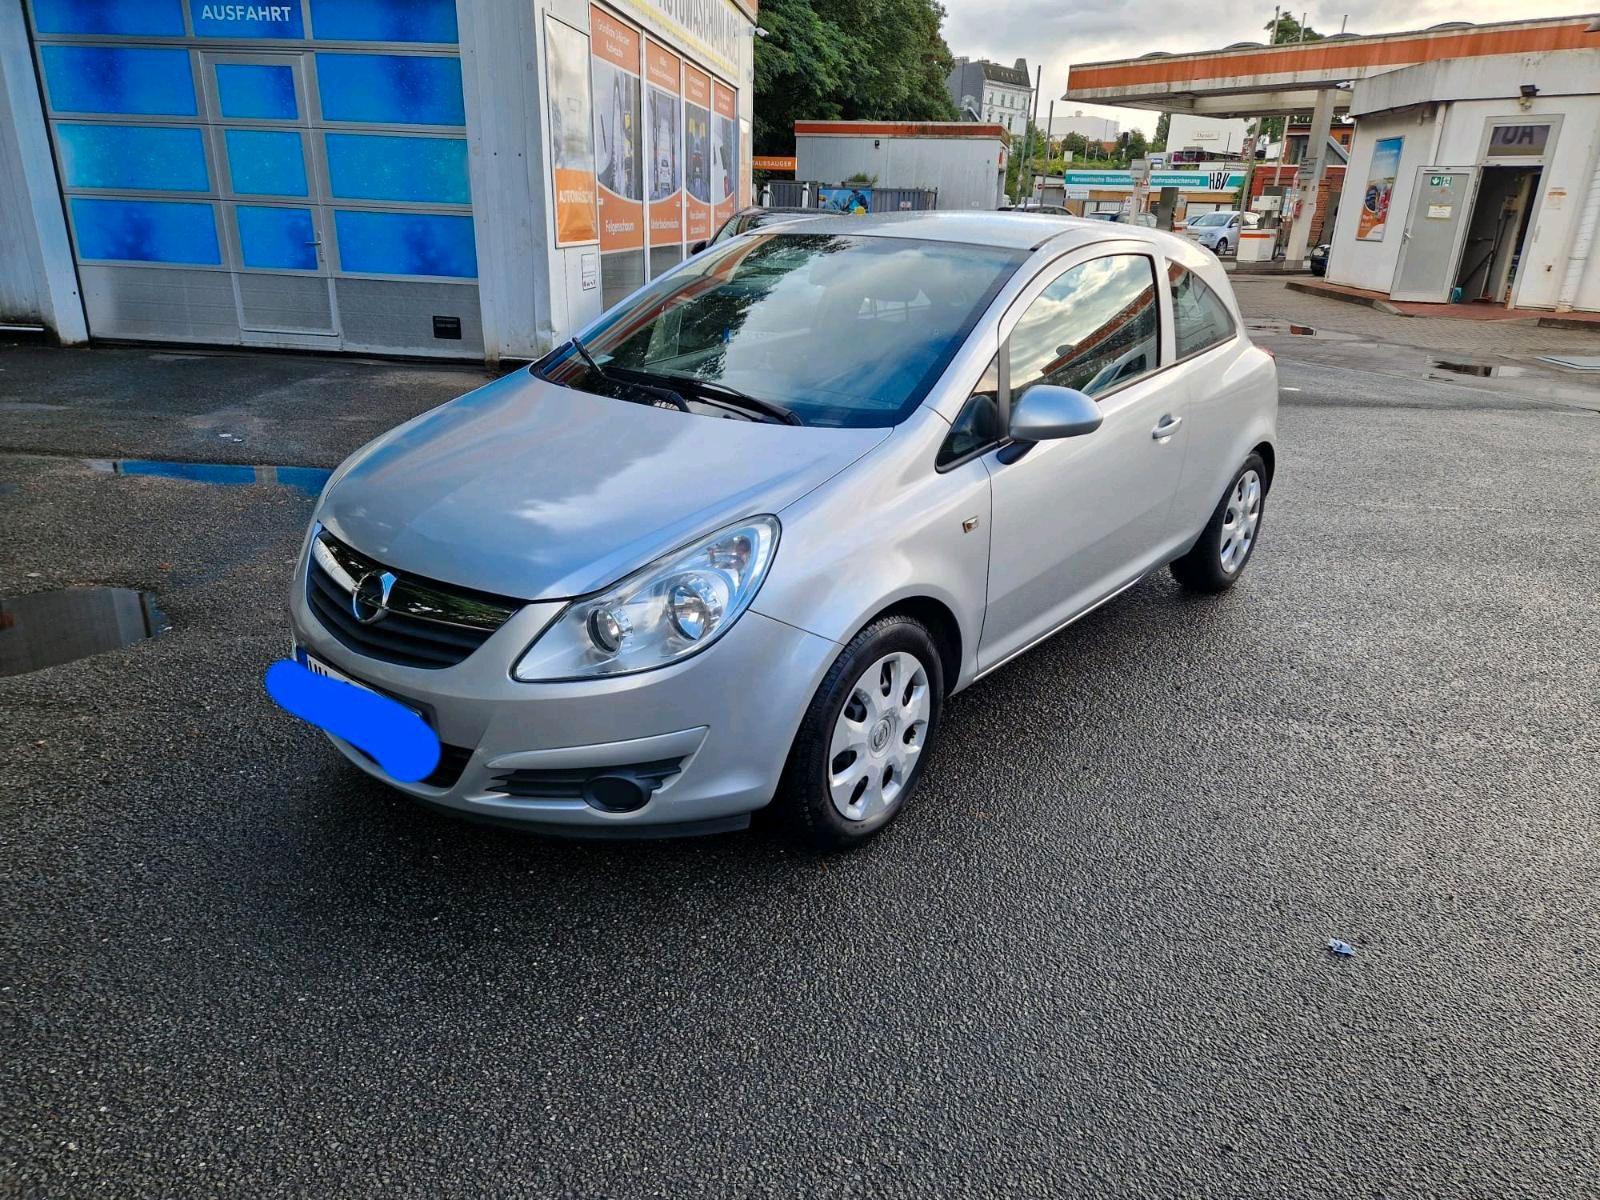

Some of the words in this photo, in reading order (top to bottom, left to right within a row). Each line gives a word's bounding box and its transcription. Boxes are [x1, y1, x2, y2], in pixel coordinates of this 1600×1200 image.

[201, 5, 292, 22] AUSFAHRT
[657, 0, 738, 67] WASCHANLAGE
[1209, 172, 1231, 190] HBV
